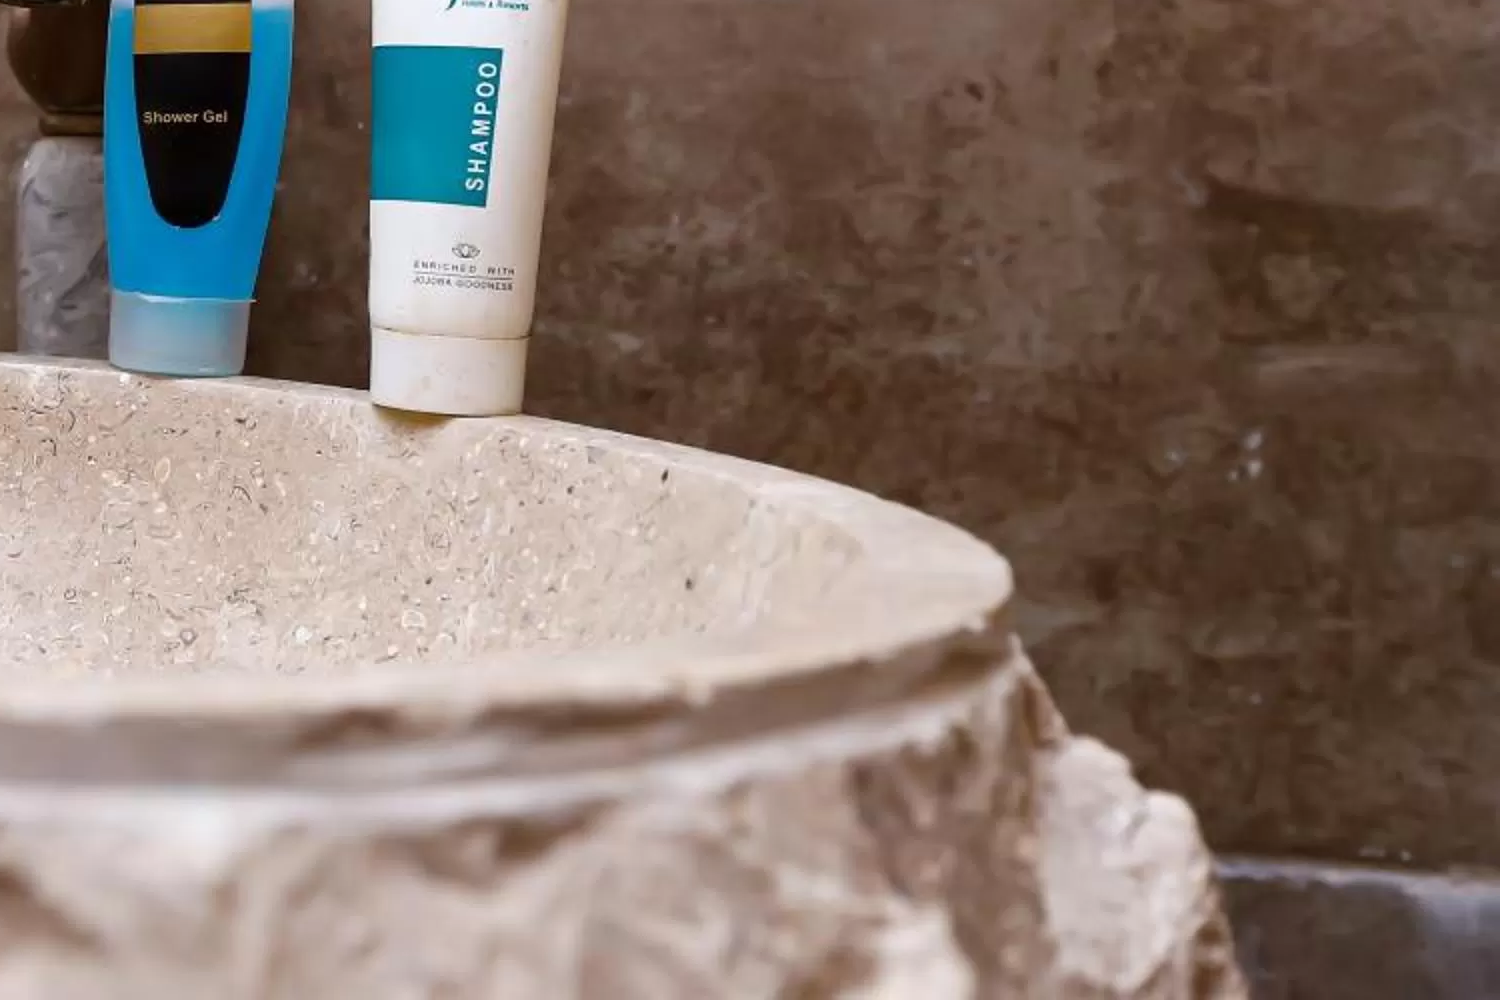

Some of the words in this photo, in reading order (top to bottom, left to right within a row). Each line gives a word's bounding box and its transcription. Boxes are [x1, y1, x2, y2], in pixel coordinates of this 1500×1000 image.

[143, 110, 199, 124] Shower
[203, 109, 228, 123] Gel
[465, 62, 498, 191] SHAMPOO
